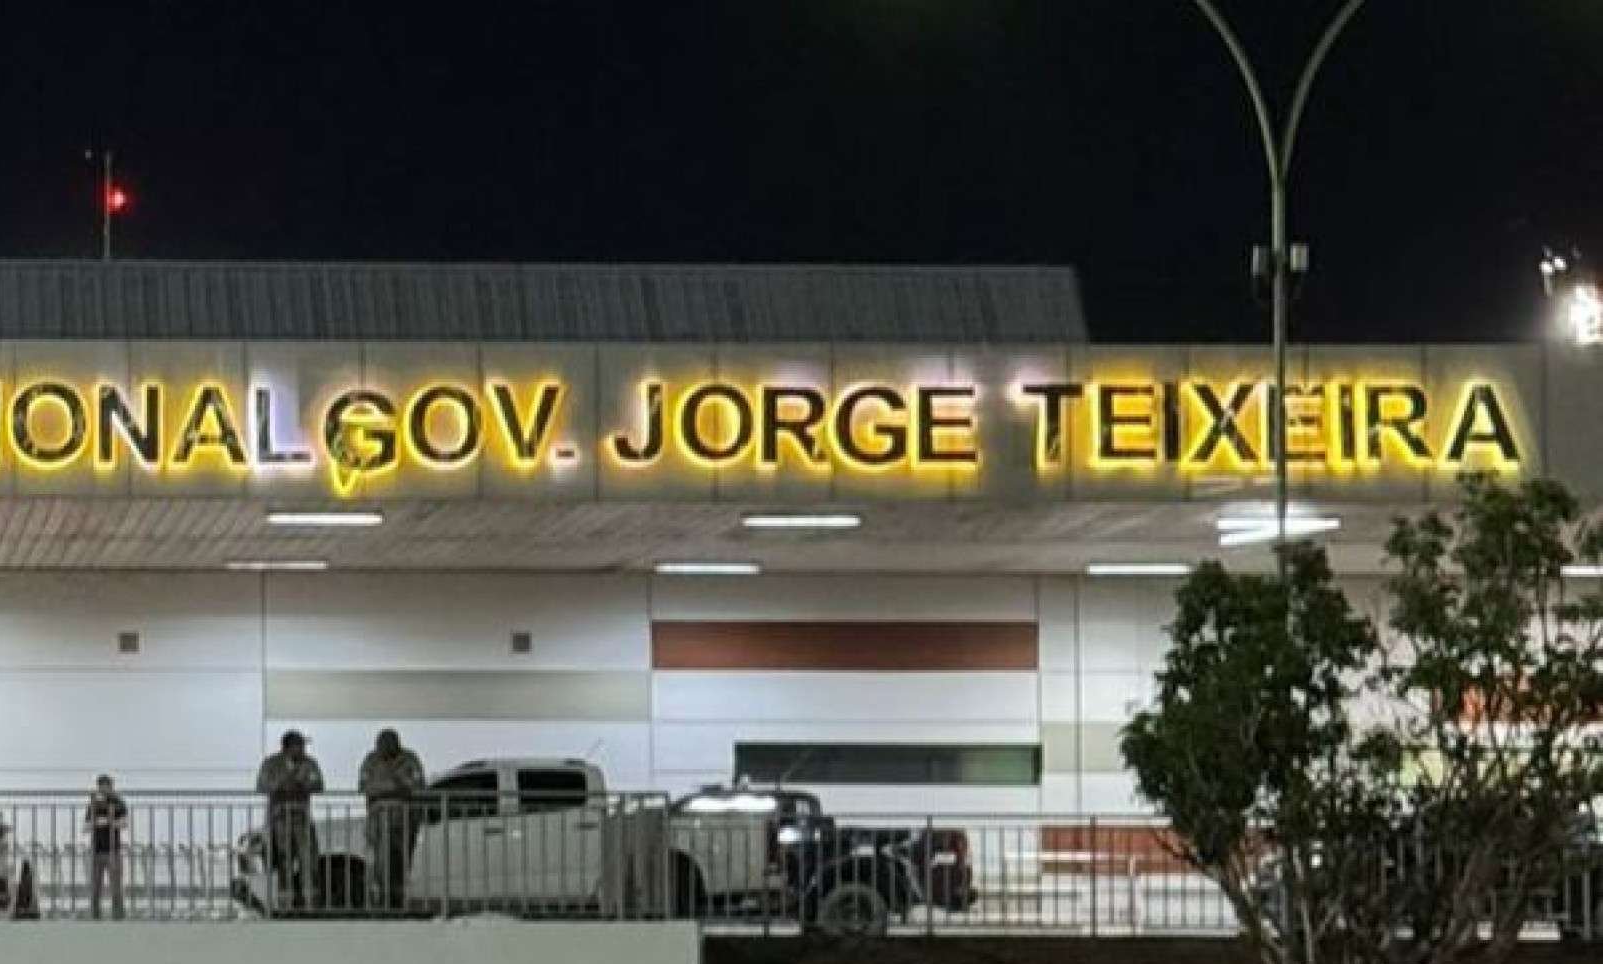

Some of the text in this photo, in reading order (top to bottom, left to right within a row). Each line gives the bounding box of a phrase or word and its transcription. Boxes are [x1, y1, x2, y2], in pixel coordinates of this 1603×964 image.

[325, 385, 574, 470] GOV.
[613, 382, 979, 464] JORGE
[1022, 383, 1520, 461] TEIXEIRA
